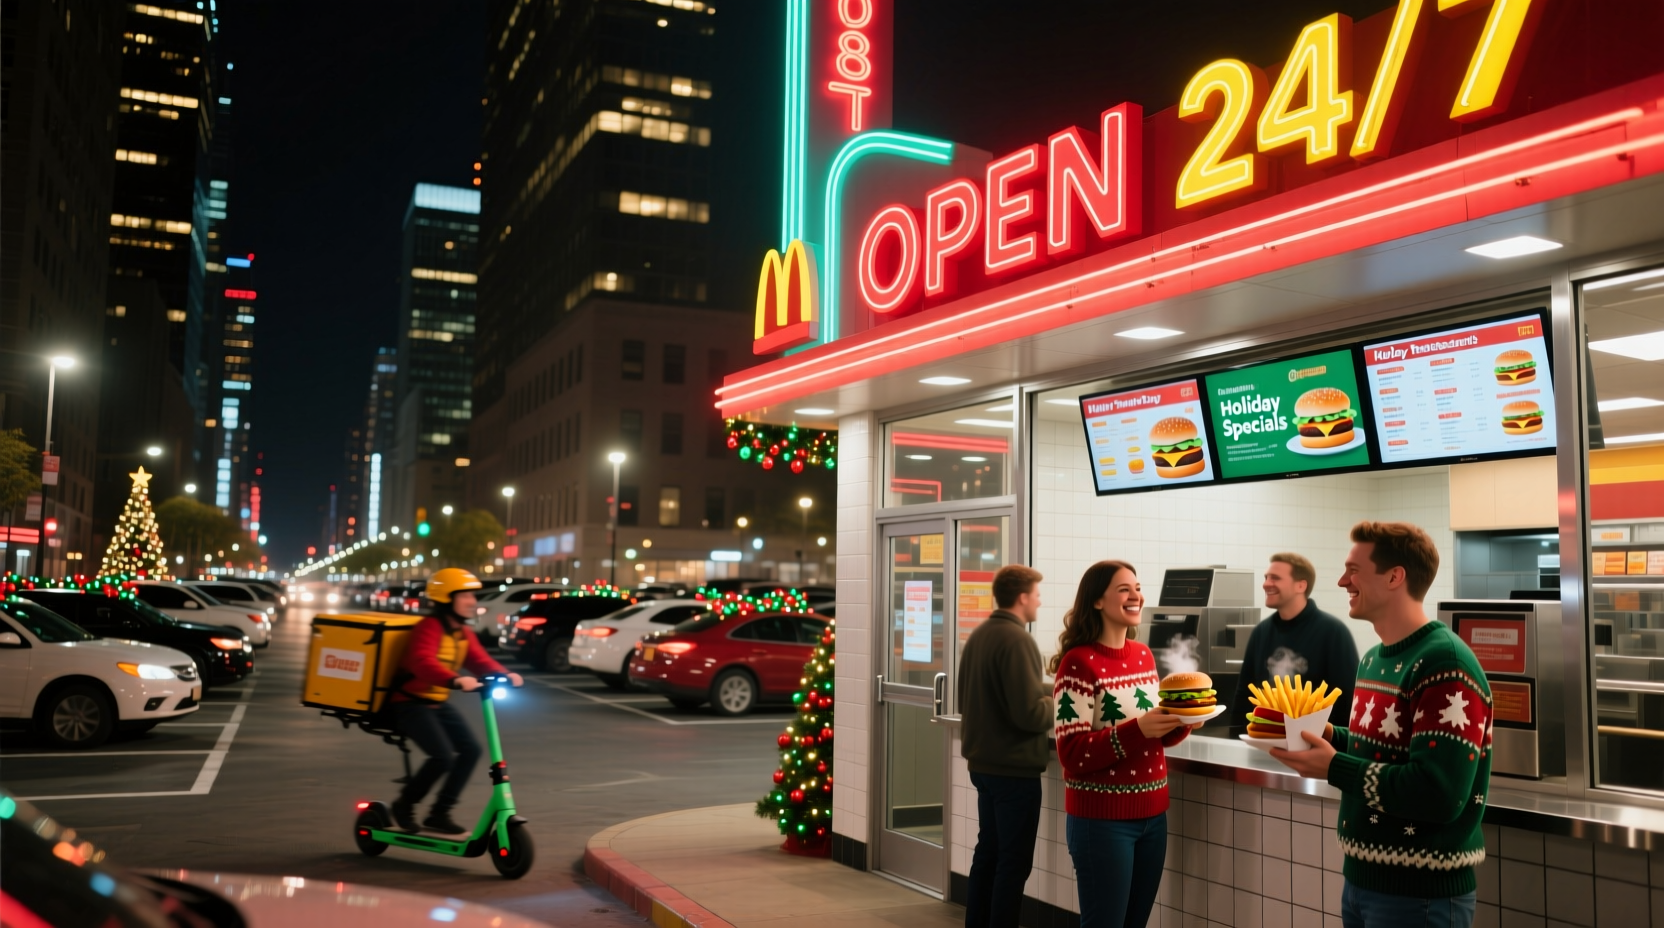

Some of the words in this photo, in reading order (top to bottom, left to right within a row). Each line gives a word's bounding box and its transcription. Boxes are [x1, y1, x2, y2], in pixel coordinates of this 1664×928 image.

[858, 101, 1140, 314] OPEN
[1176, 0, 1532, 210] 24/7
[1220, 394, 1281, 417] Holiday
[1222, 412, 1289, 441] Specials
